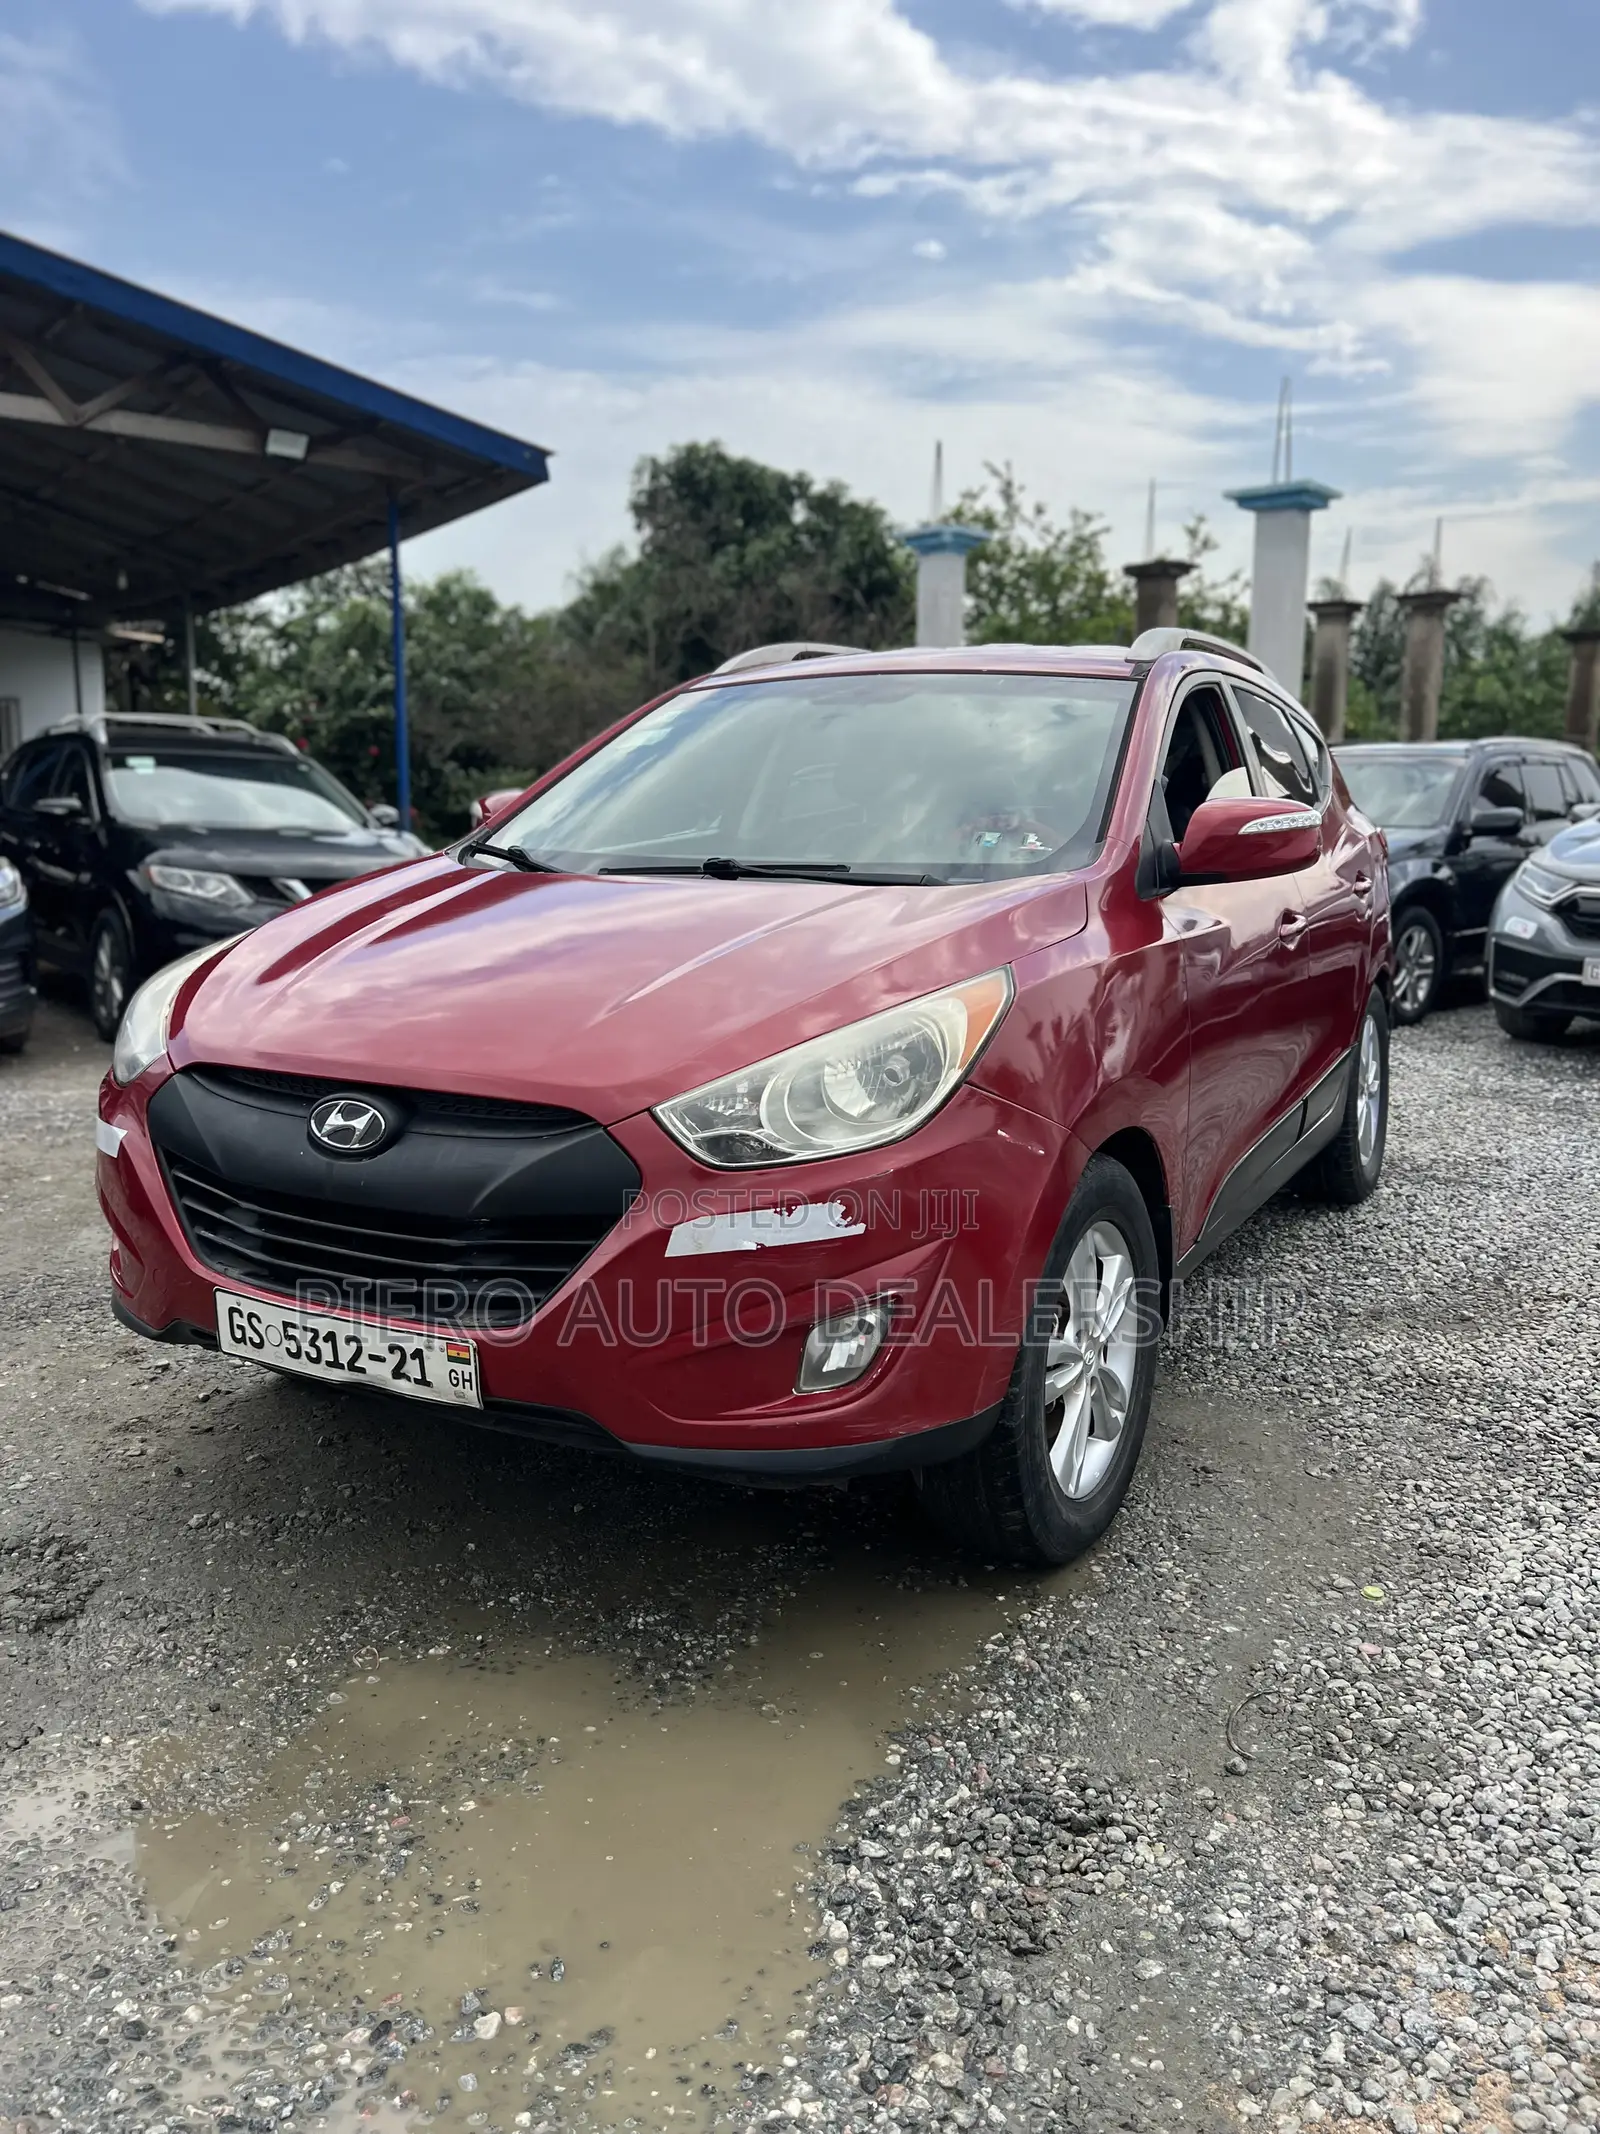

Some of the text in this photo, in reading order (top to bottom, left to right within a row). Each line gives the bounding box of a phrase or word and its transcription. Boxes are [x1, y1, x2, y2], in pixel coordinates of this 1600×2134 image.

[228, 1306, 434, 1388] GS 5312-21
[448, 1368, 474, 1391] GH
